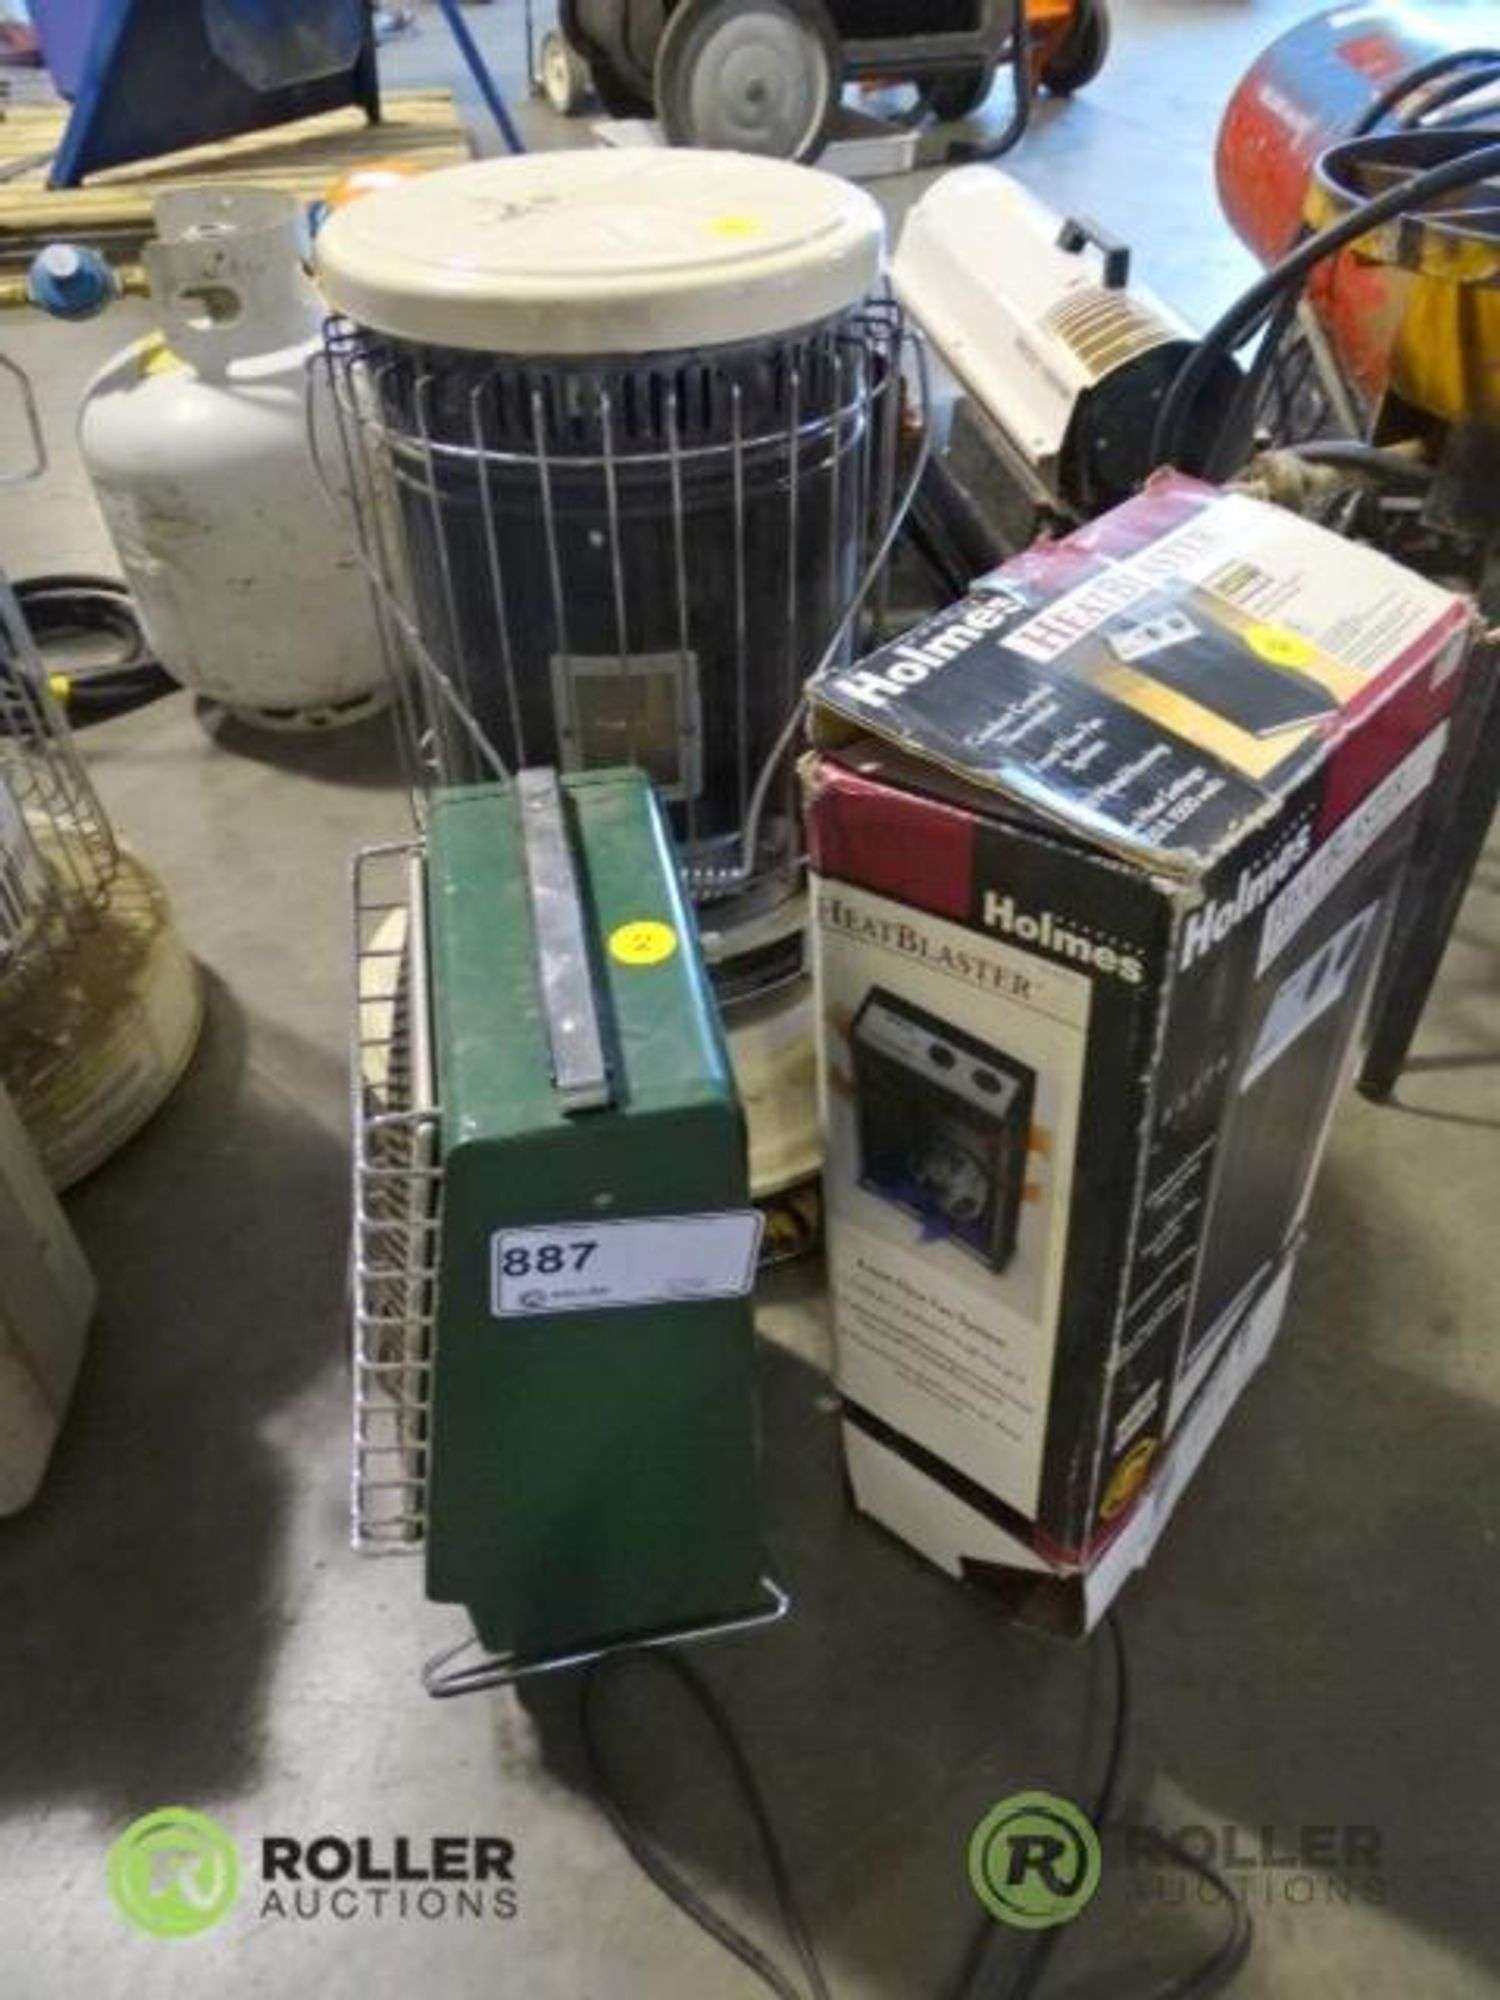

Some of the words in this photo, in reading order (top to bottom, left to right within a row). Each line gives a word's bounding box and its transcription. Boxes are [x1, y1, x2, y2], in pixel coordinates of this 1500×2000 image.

[835, 595, 1026, 708] Holmes
[983, 891, 1143, 984] Holmes
[1180, 824, 1311, 972] Holmes
[502, 1241, 600, 1277] 887
